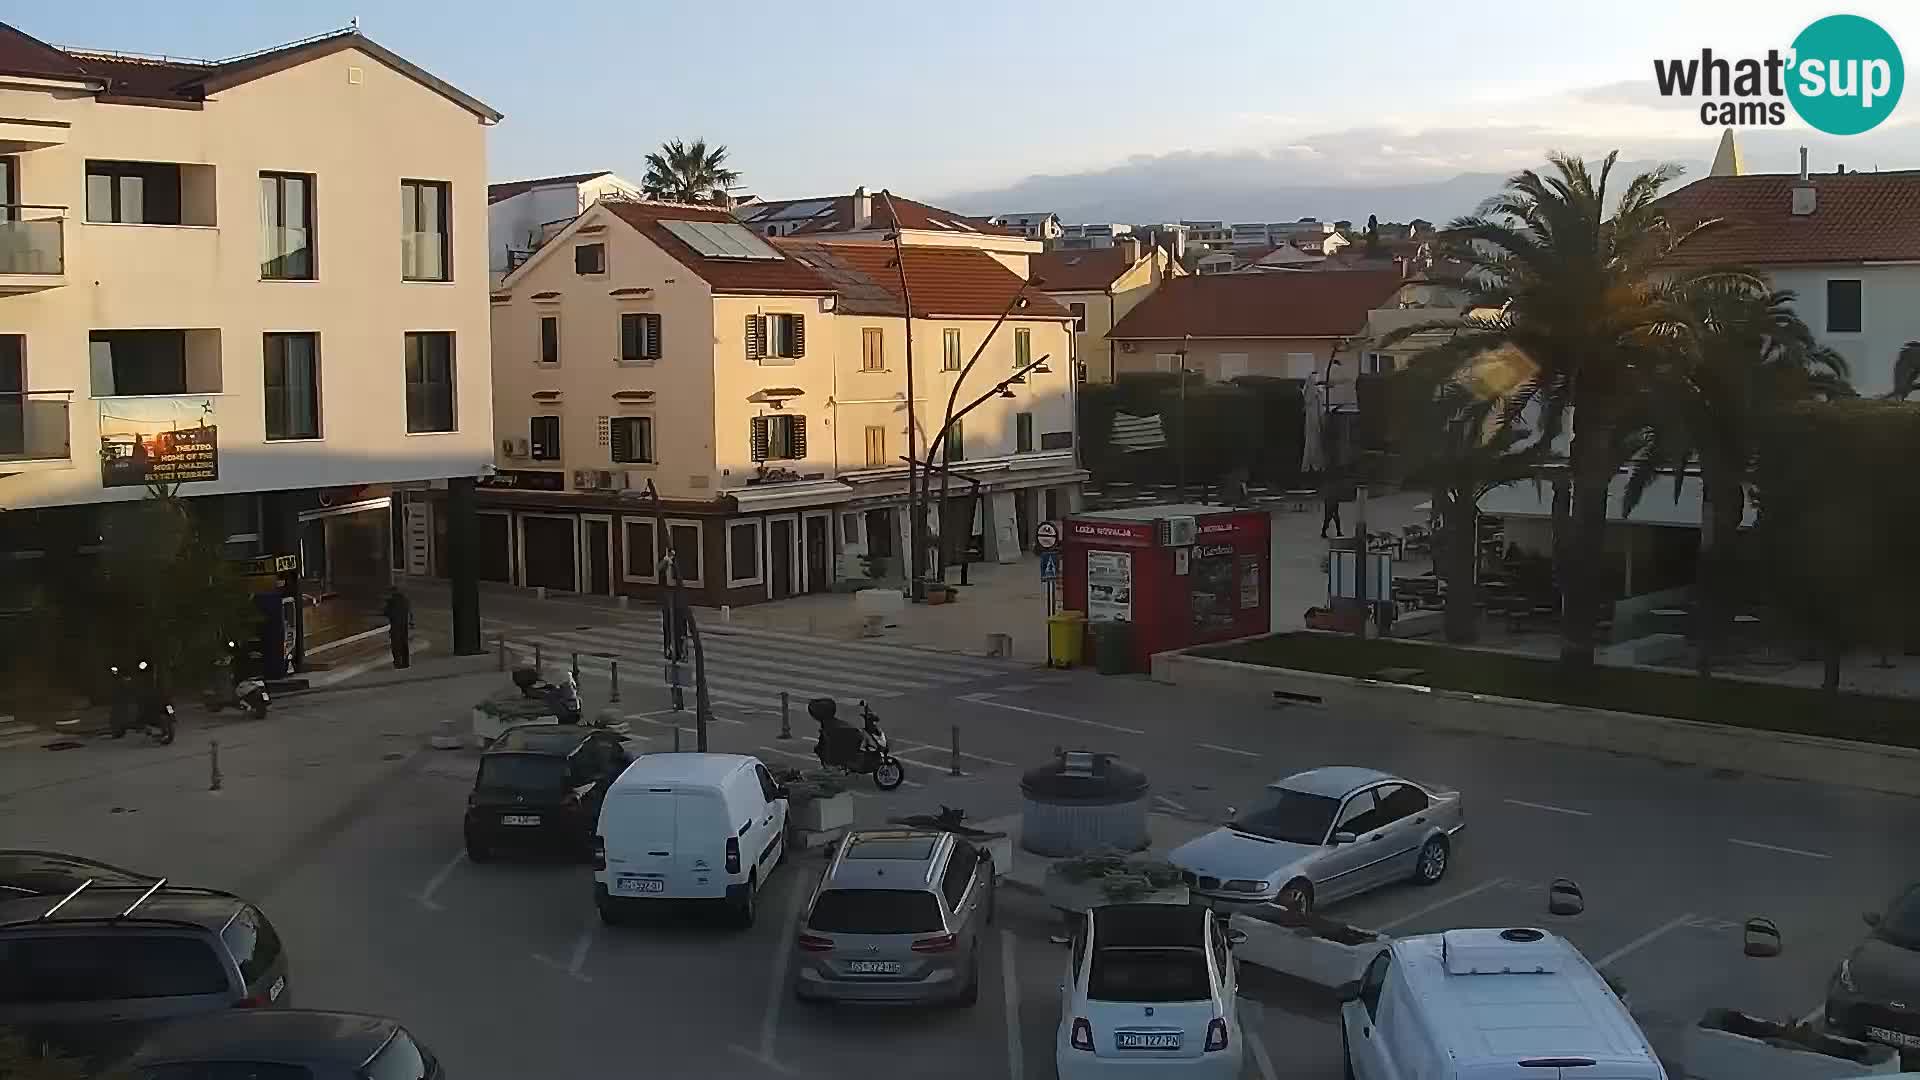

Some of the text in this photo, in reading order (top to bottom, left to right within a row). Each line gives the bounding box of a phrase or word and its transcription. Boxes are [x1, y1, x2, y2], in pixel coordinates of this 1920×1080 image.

[161, 452, 213, 462] HOME OF THE
[153, 461, 214, 471] MOST AMAZING
[278, 557, 296, 571] ATM
